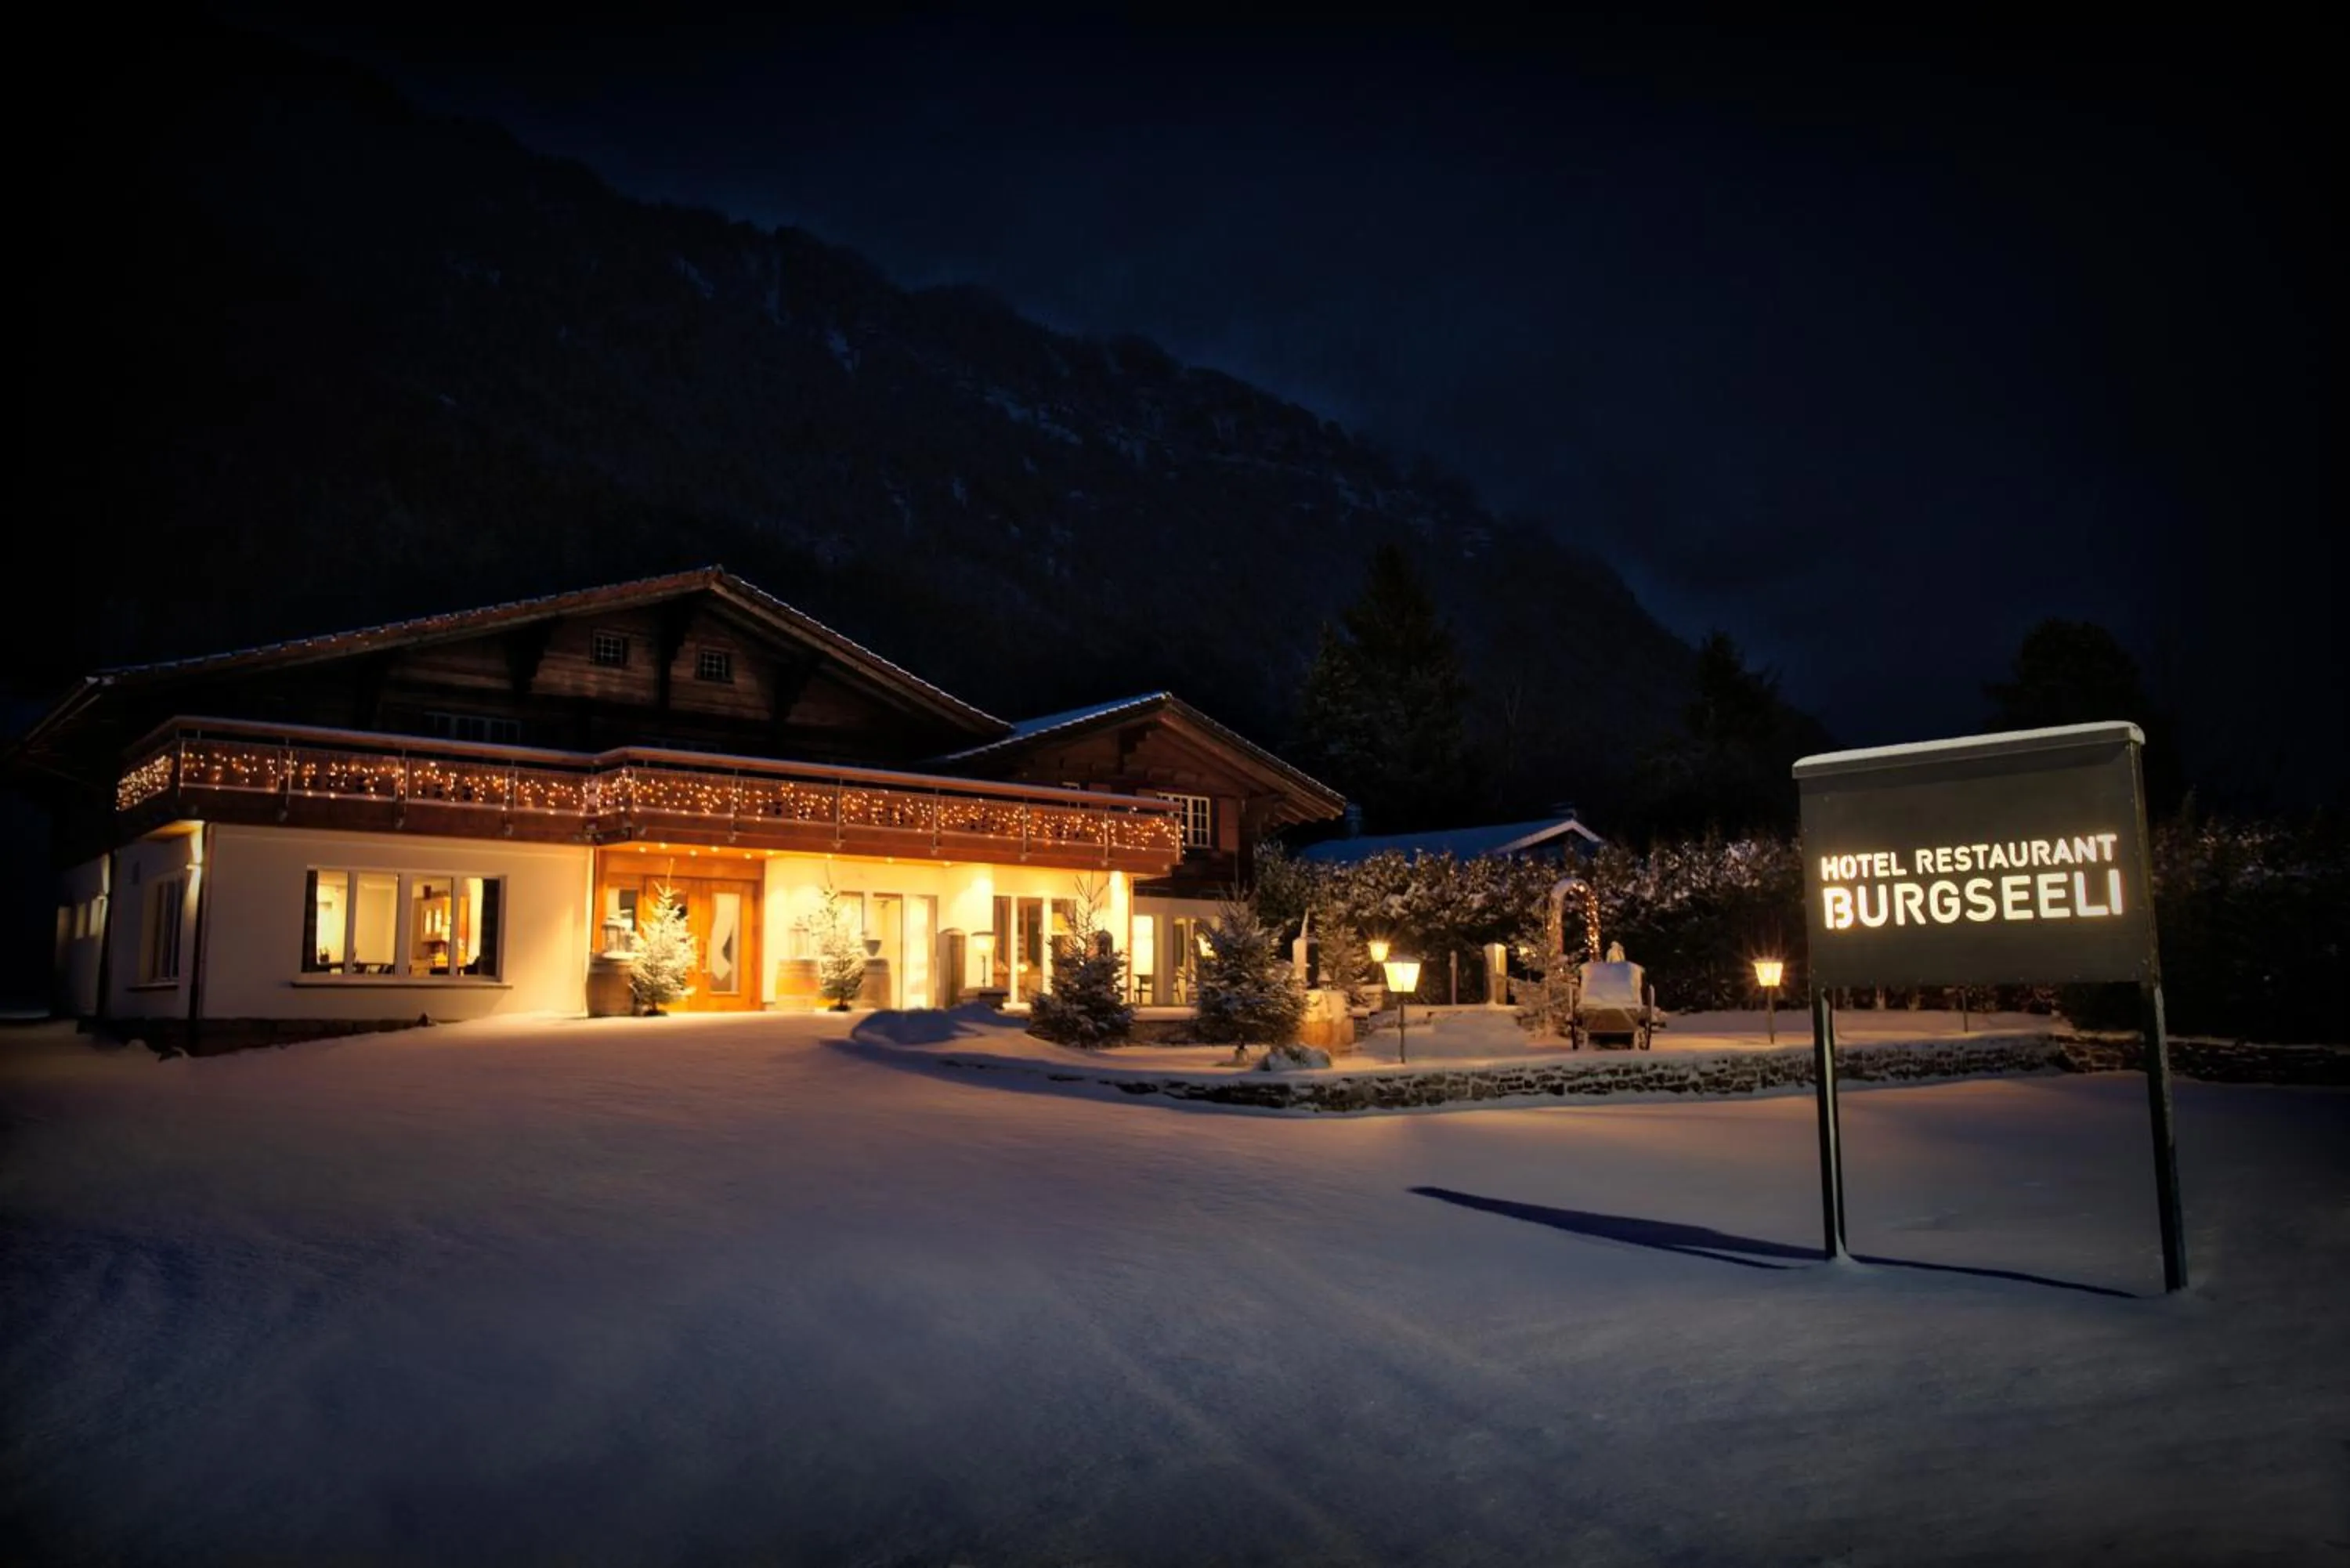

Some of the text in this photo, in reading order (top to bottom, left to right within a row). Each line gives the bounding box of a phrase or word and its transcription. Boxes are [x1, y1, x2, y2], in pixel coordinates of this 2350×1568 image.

[1820, 833, 2117, 881] HOTEL RESTAURANT
[1822, 868, 2123, 930] BURGSEELI
